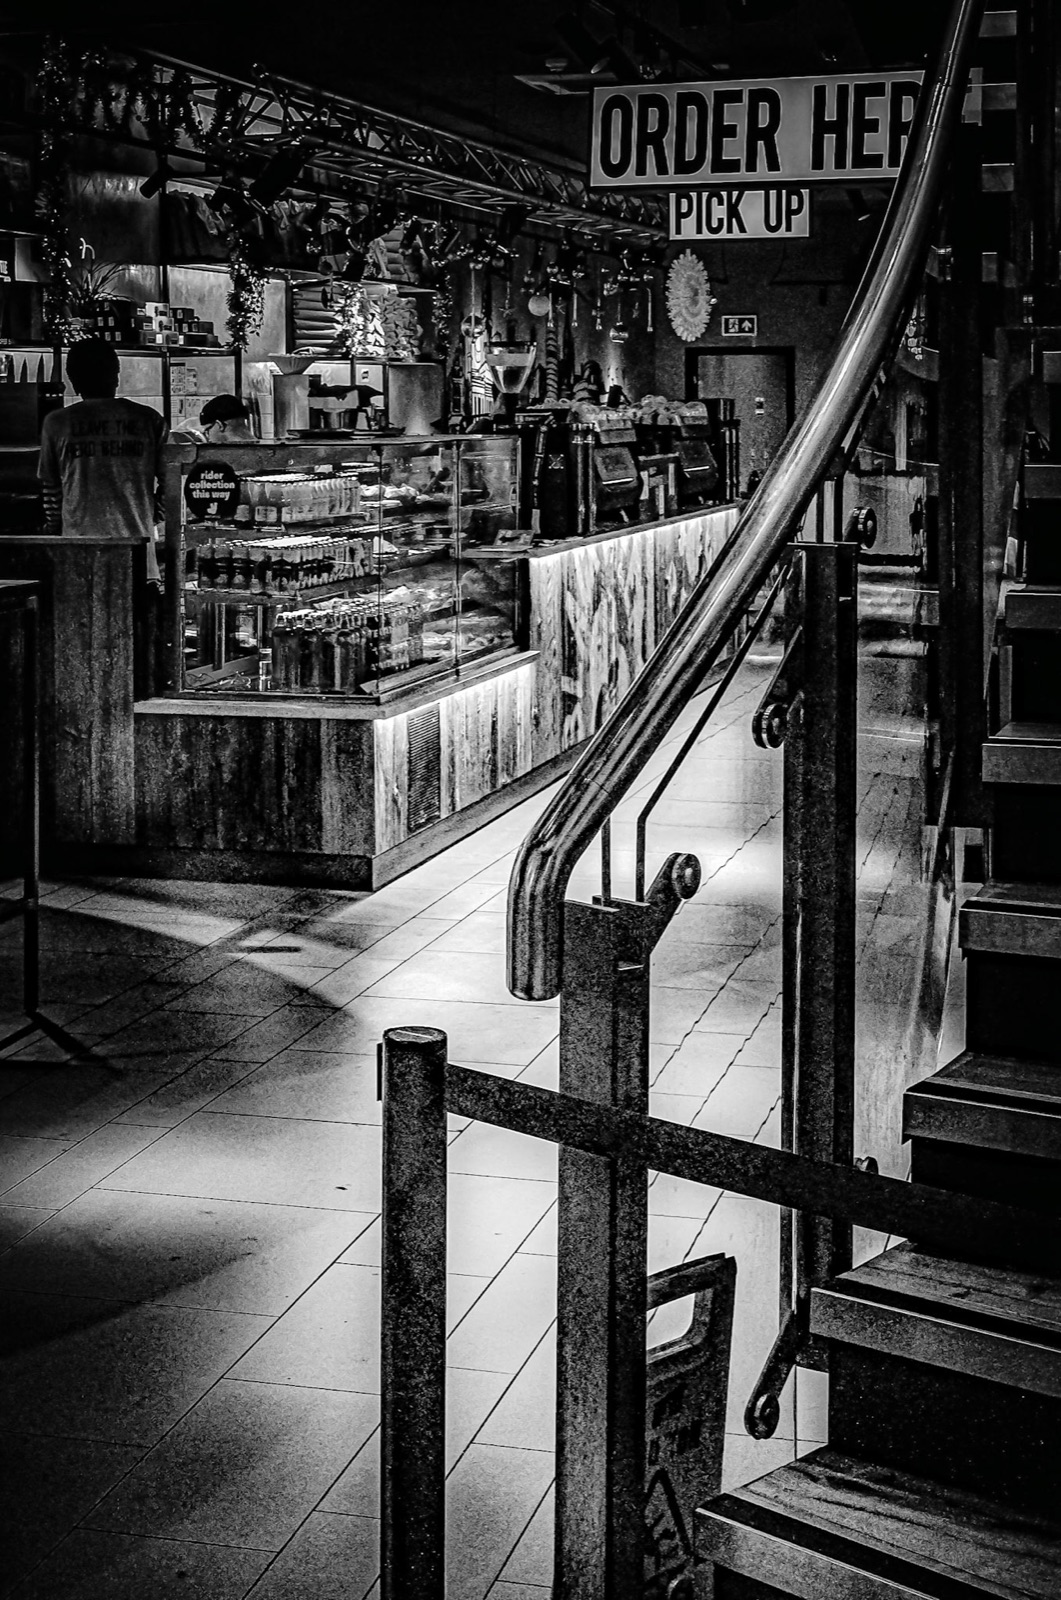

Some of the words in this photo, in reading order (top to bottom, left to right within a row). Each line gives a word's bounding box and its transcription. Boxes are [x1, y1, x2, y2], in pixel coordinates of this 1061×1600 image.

[599, 87, 782, 179] ORDER
[674, 191, 748, 235] PICK
[763, 189, 805, 234] UP
[71, 420, 110, 437] LEAVE
[115, 419, 139, 436] THE
[101, 439, 144, 458] BEHIND
[200, 470, 224, 480] rider
[189, 480, 236, 489] collection
[192, 489, 211, 498] this
[211, 491, 231, 501] way
